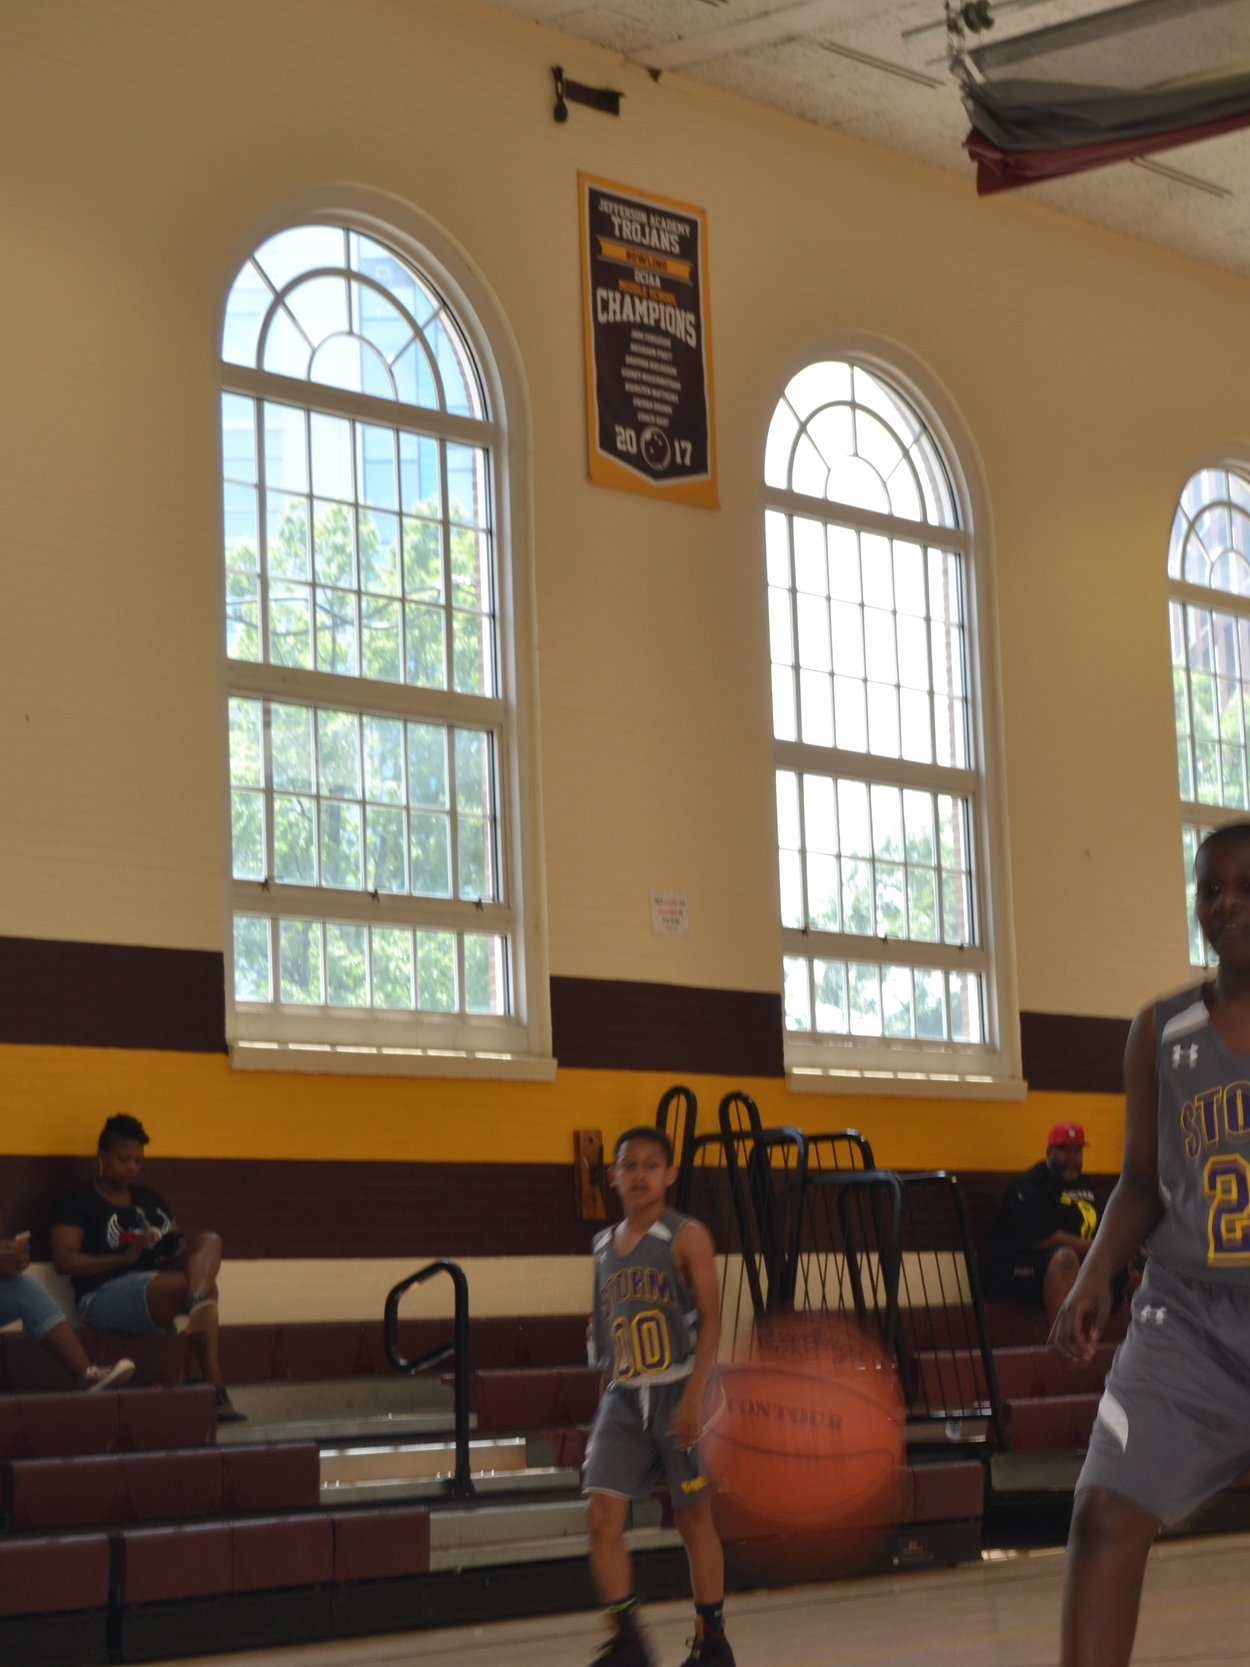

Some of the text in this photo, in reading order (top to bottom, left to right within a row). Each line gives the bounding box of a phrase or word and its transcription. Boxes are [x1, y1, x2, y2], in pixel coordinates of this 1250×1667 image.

[598, 197, 691, 238] JEFFERSON ACADEMY
[611, 215, 680, 255] TROJANS
[597, 288, 697, 349] CHAMPIONS
[615, 425, 692, 466] 20 17
[726, 1398, 844, 1431] CONTOUR
